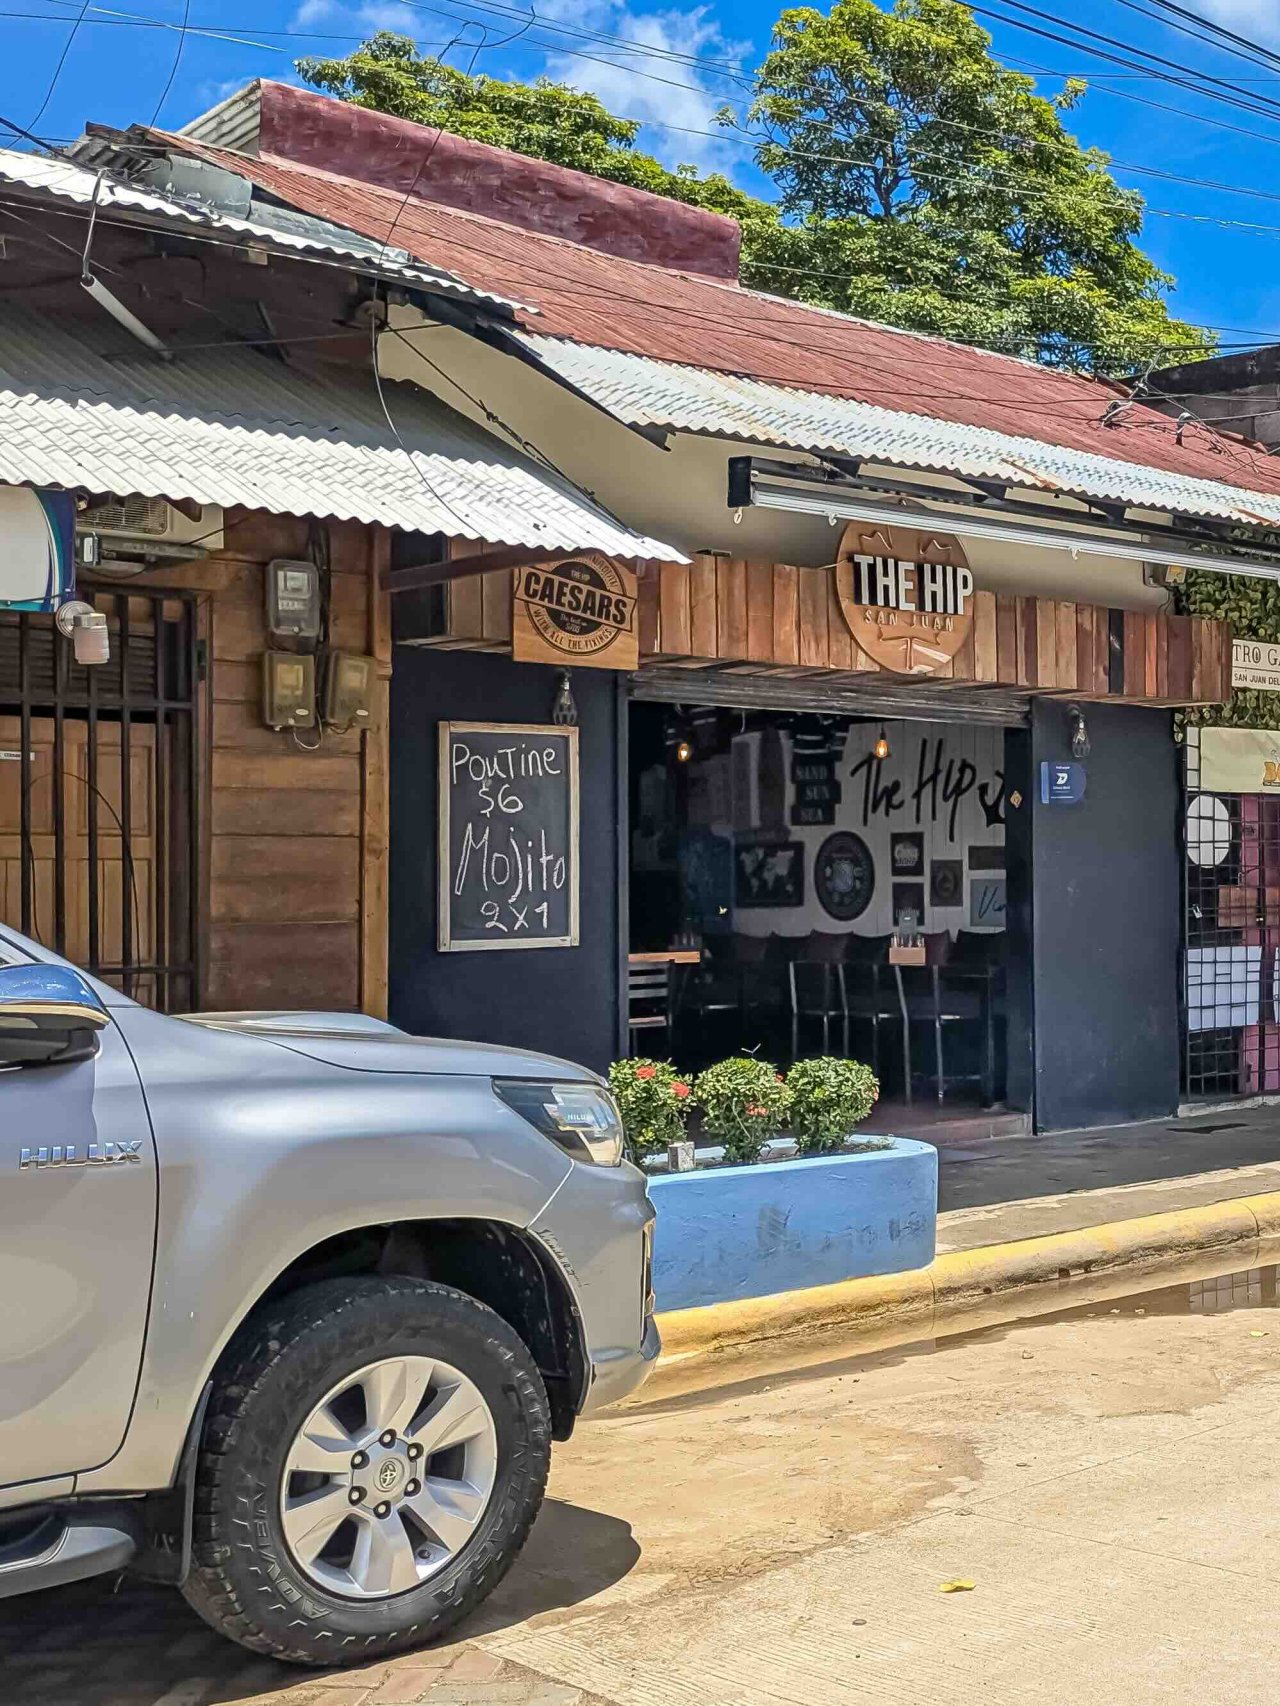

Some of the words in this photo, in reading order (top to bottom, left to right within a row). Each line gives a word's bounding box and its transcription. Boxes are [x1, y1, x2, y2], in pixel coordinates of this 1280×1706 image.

[524, 571, 627, 625] CAESARS
[854, 554, 916, 611] THE
[923, 563, 974, 615] HIP
[533, 608, 551, 633] WITH
[549, 629, 564, 646] ALL
[567, 639, 583, 650] THE
[584, 628, 613, 650] FIXINGS
[864, 608, 898, 626] SAN
[910, 614, 955, 632] JUAN
[1234, 673, 1248, 682] SAN
[1250, 675, 1267, 684] JUAN
[1268, 677, 1280, 686] DEL
[796, 765, 829, 780] SAND
[478, 781, 524, 818] $6
[805, 784, 831, 800] SUN
[850, 752, 905, 827] The
[800, 807, 824, 822] SEA
[455, 822, 566, 904] Mojito
[567, 1113, 593, 1121] HILU
[20, 1140, 142, 1170] HILUX
